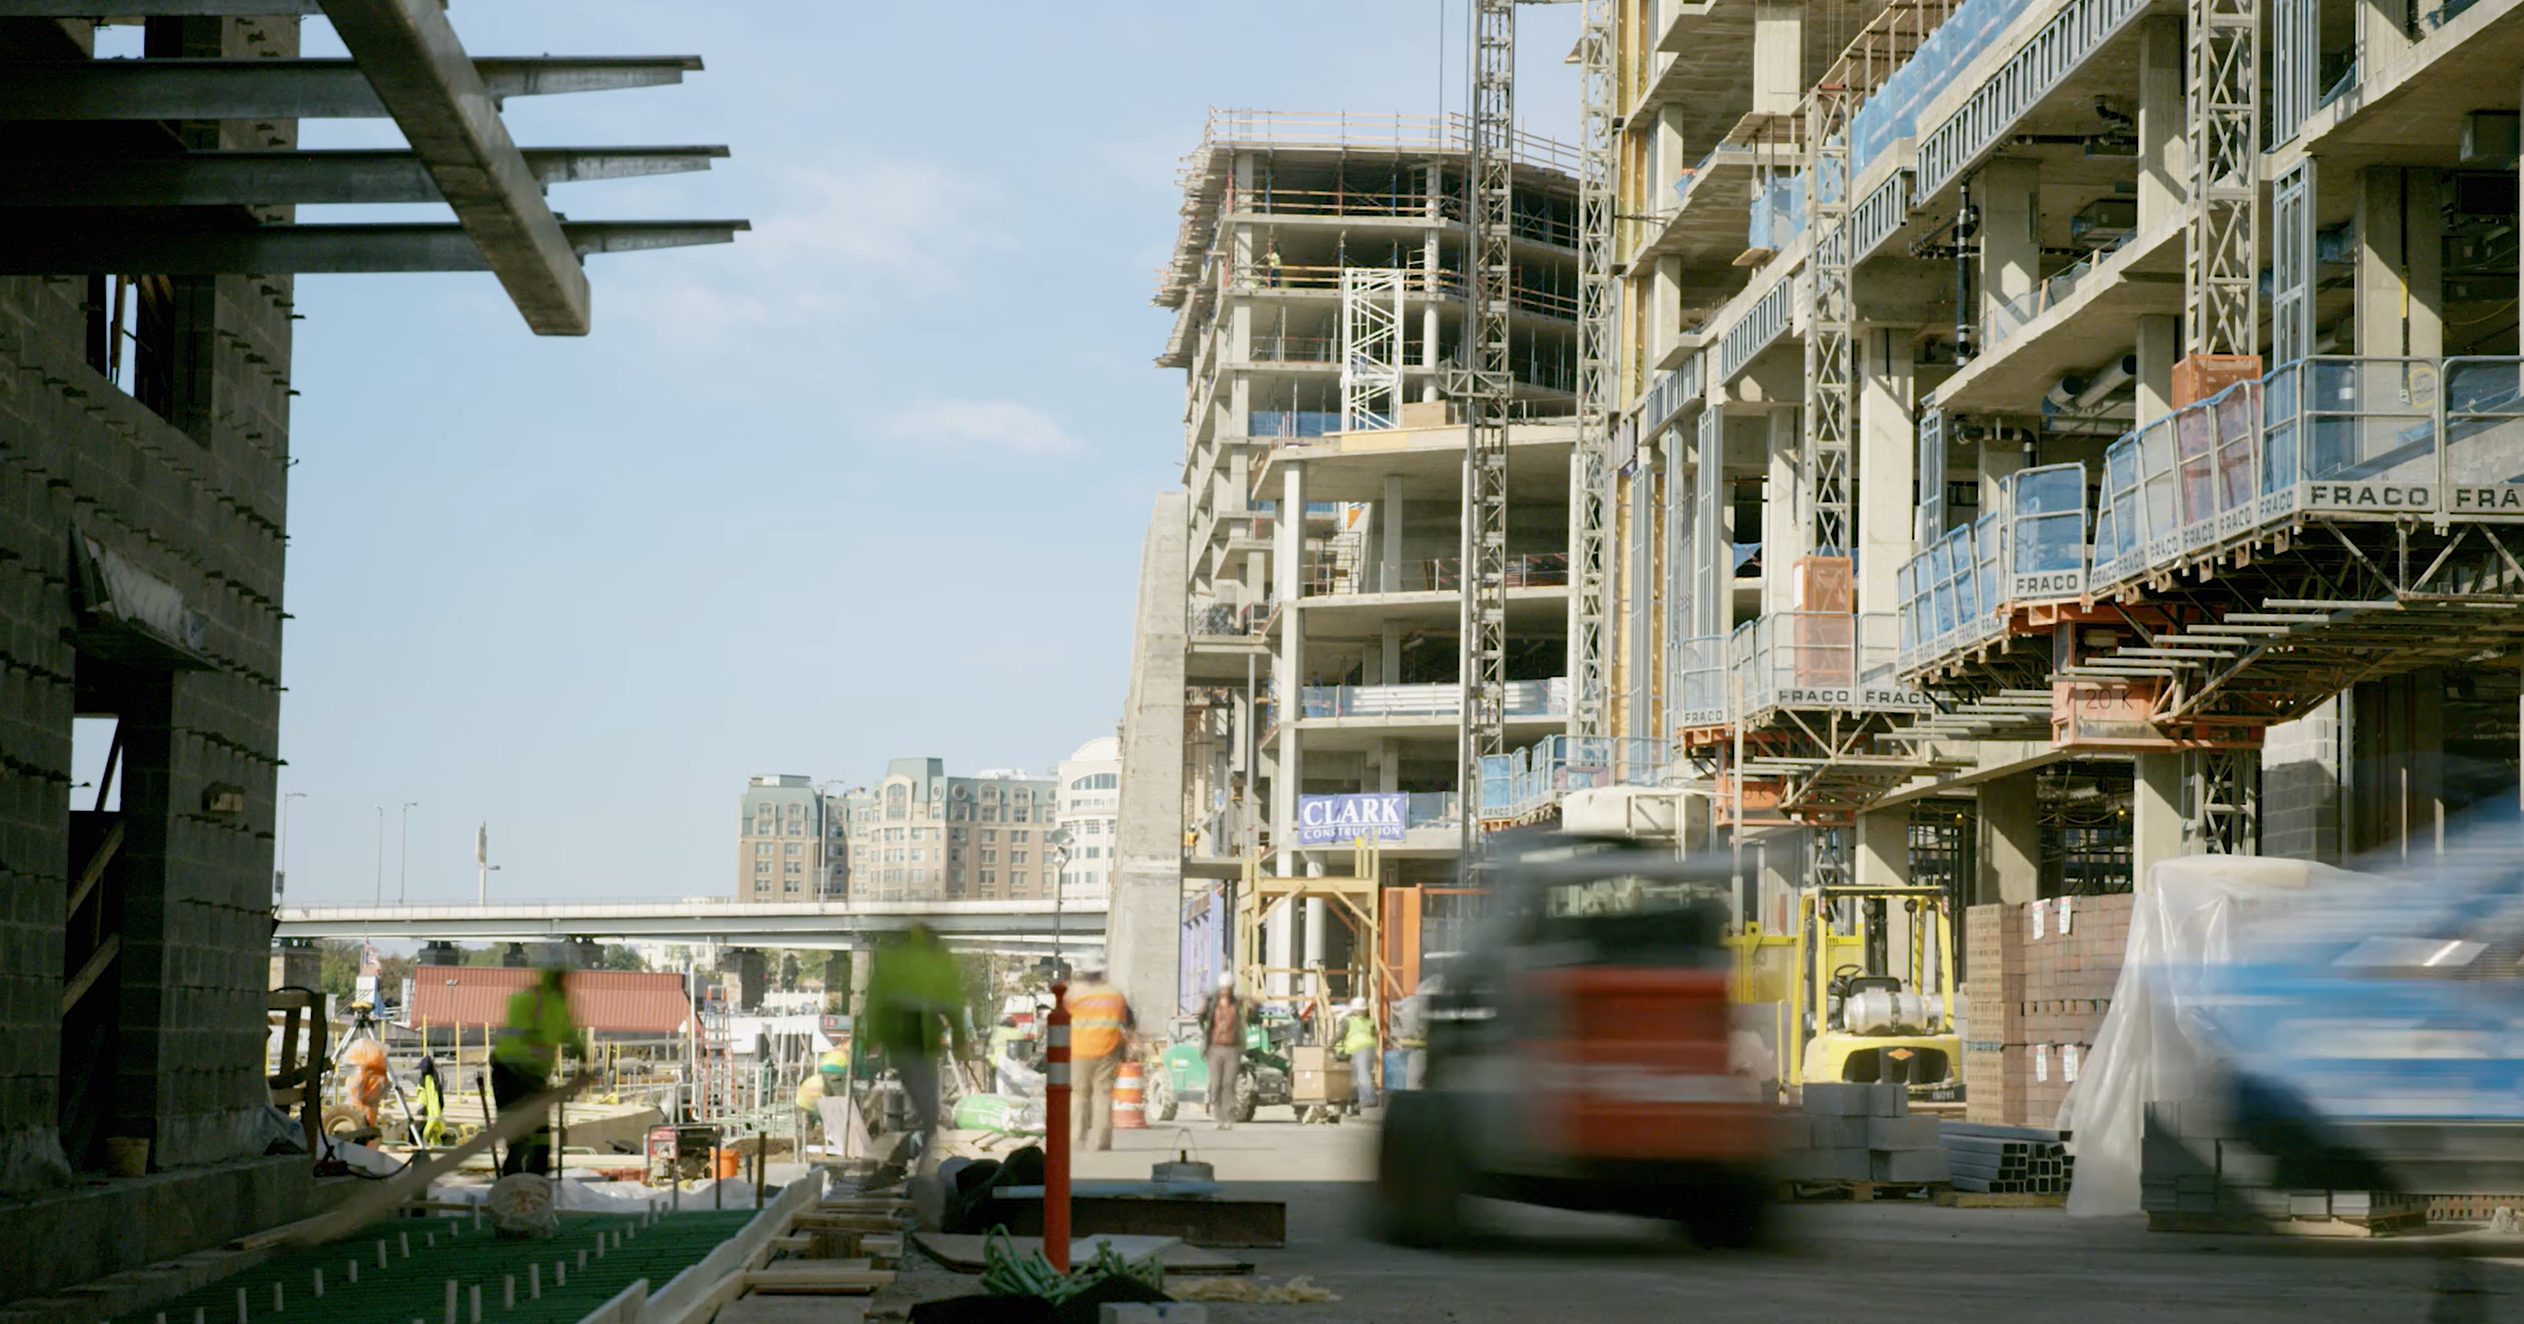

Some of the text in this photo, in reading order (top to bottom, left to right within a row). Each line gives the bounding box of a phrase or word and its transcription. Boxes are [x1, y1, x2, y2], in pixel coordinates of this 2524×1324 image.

[2259, 490, 2294, 520] FRACO
[2310, 485, 2430, 506] FRACO
[2218, 508, 2252, 536] FRACO
[2183, 523, 2215, 546] FRACO
[2016, 574, 2078, 594] FRACO
[1779, 690, 1849, 703] FRACO
[2084, 688, 2134, 710] 20 K
[1685, 709, 1723, 723] FRACO
[1303, 797, 1401, 827] CLARK
